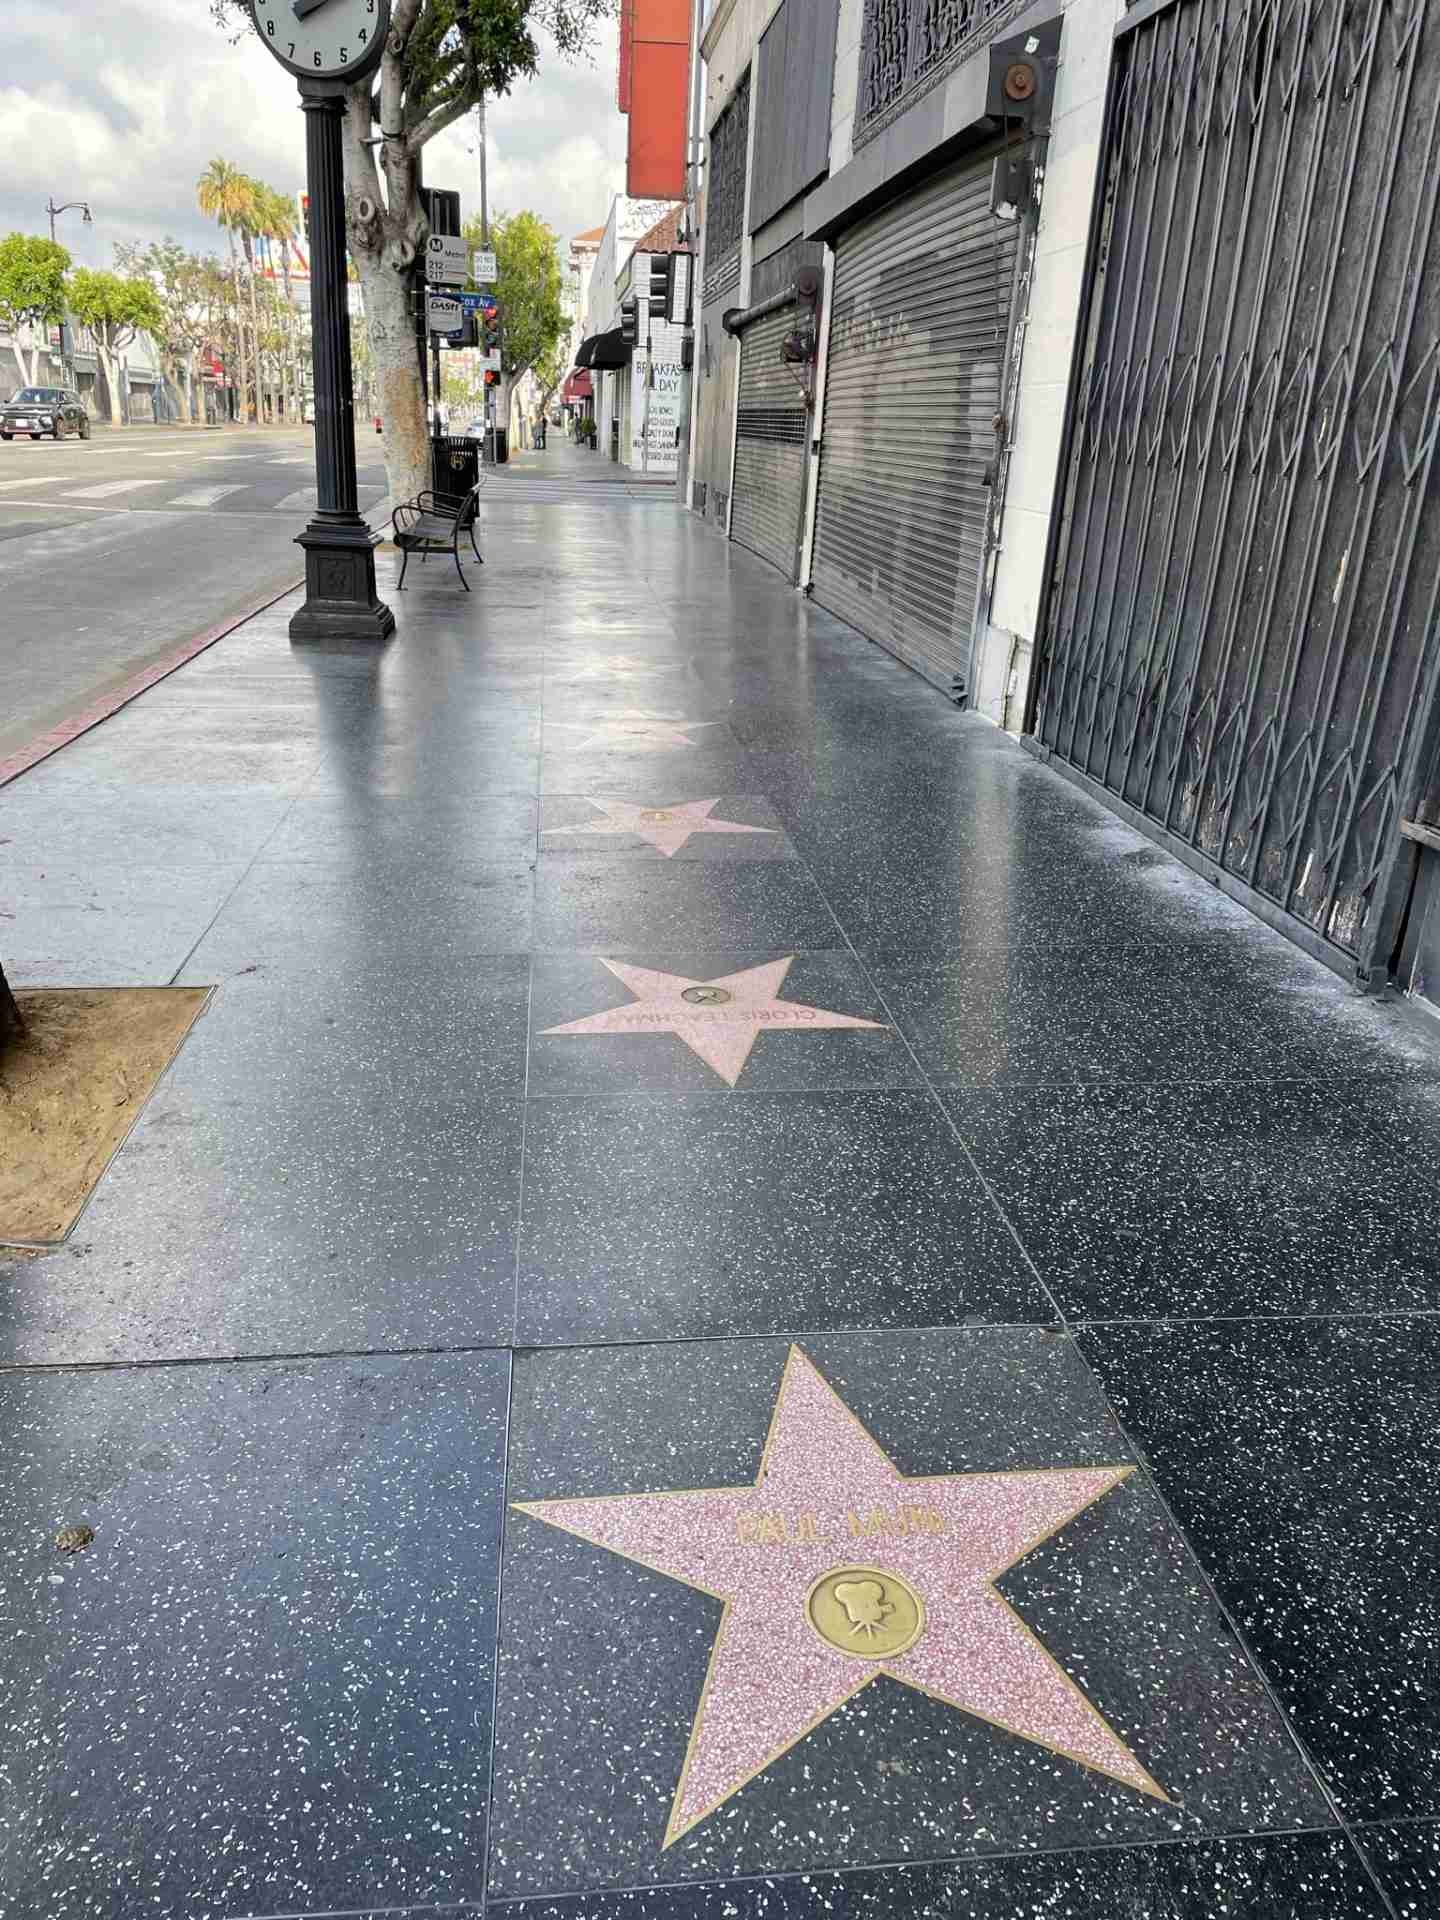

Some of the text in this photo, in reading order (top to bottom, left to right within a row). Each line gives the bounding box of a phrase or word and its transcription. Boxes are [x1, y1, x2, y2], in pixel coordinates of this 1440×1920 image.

[366, 0, 374, 13] 3
[266, 20, 275, 36] 8
[358, 28, 367, 44] 4
[287, 43, 296, 59] 7
[340, 47, 348, 63] 5
[313, 51, 322, 67] 6
[428, 260, 444, 269] 212
[428, 271, 444, 280] 217
[430, 301, 460, 312] DASH
[659, 379, 678, 392] DAY
[740, 1008, 817, 1022] CLORIS
[735, 1507, 832, 1545] PAUL
